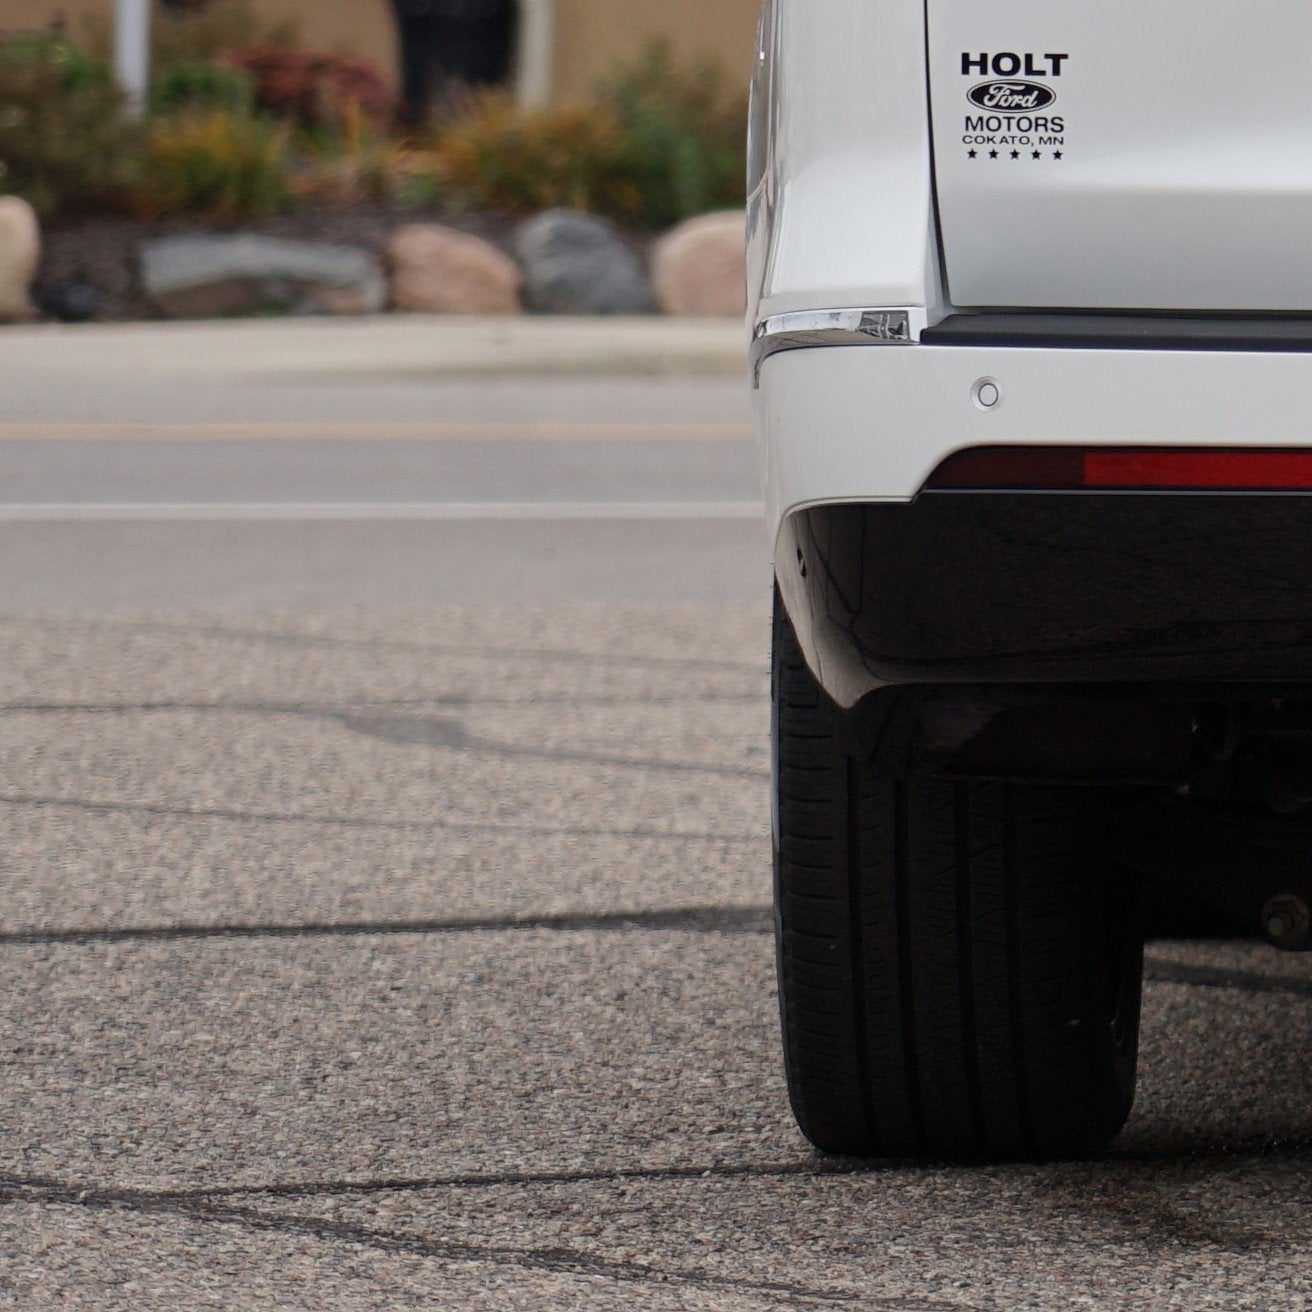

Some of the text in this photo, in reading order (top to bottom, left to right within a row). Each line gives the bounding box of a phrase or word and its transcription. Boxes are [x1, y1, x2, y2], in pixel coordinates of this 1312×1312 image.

[961, 52, 1069, 77] HOLT
[983, 84, 1039, 108] Ford
[965, 116, 1065, 133] MOTORS
[962, 135, 1064, 147] COKATO, MN
